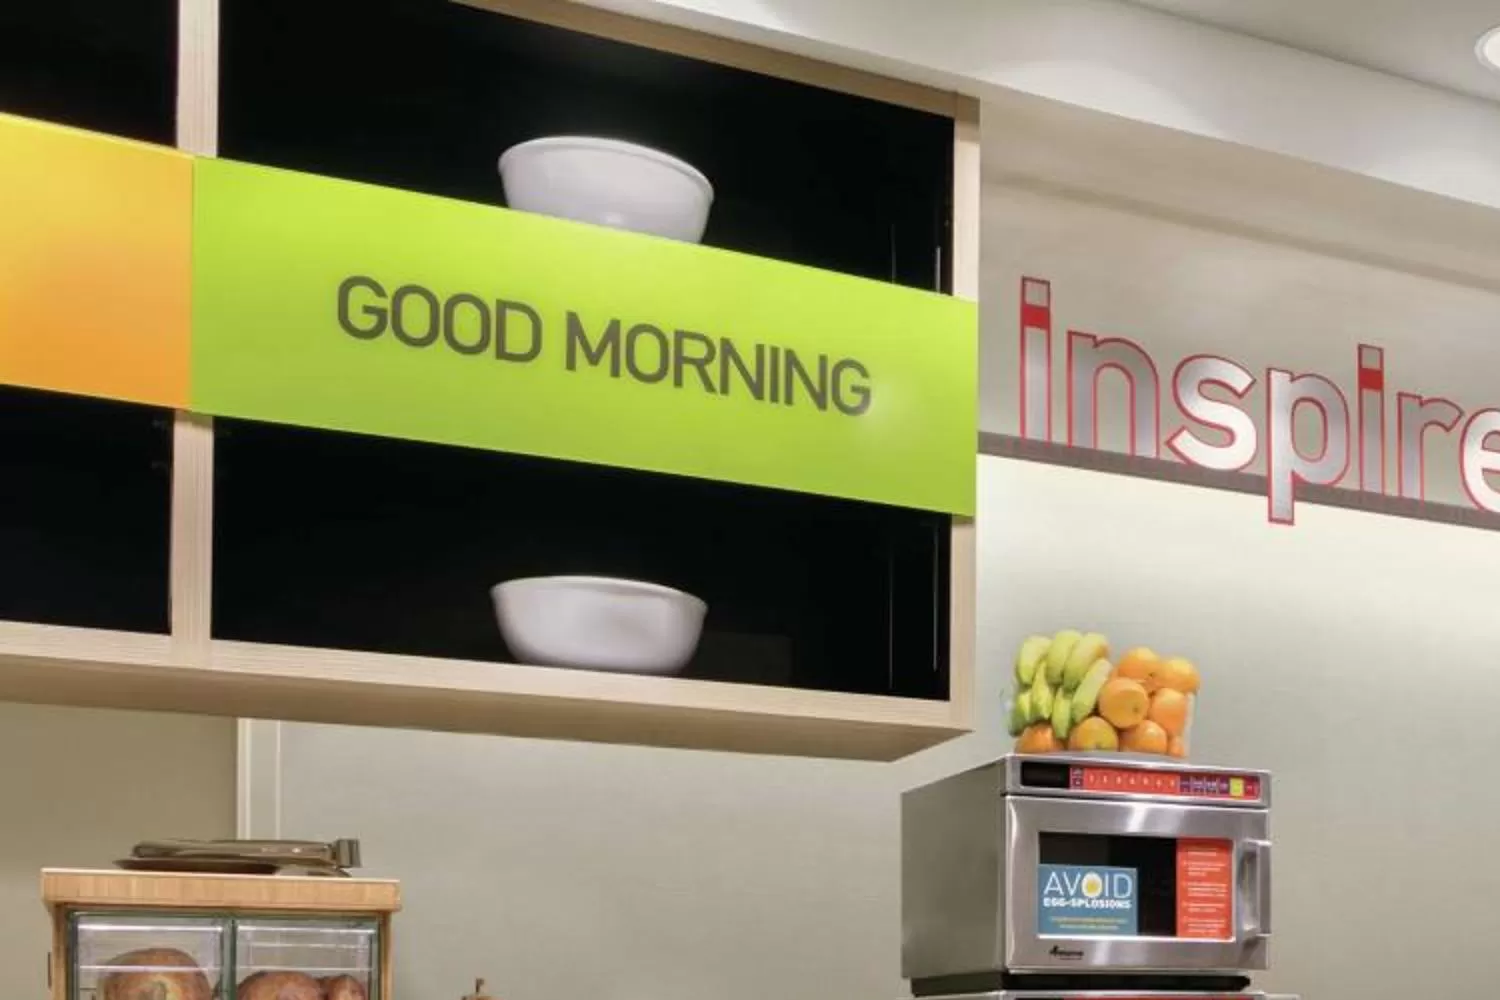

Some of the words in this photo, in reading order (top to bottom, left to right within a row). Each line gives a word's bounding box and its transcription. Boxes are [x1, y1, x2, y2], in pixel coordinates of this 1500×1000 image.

[337, 275, 542, 364] GOOD
[565, 311, 872, 416] MORNING
[1043, 871, 1133, 899] AVOID
